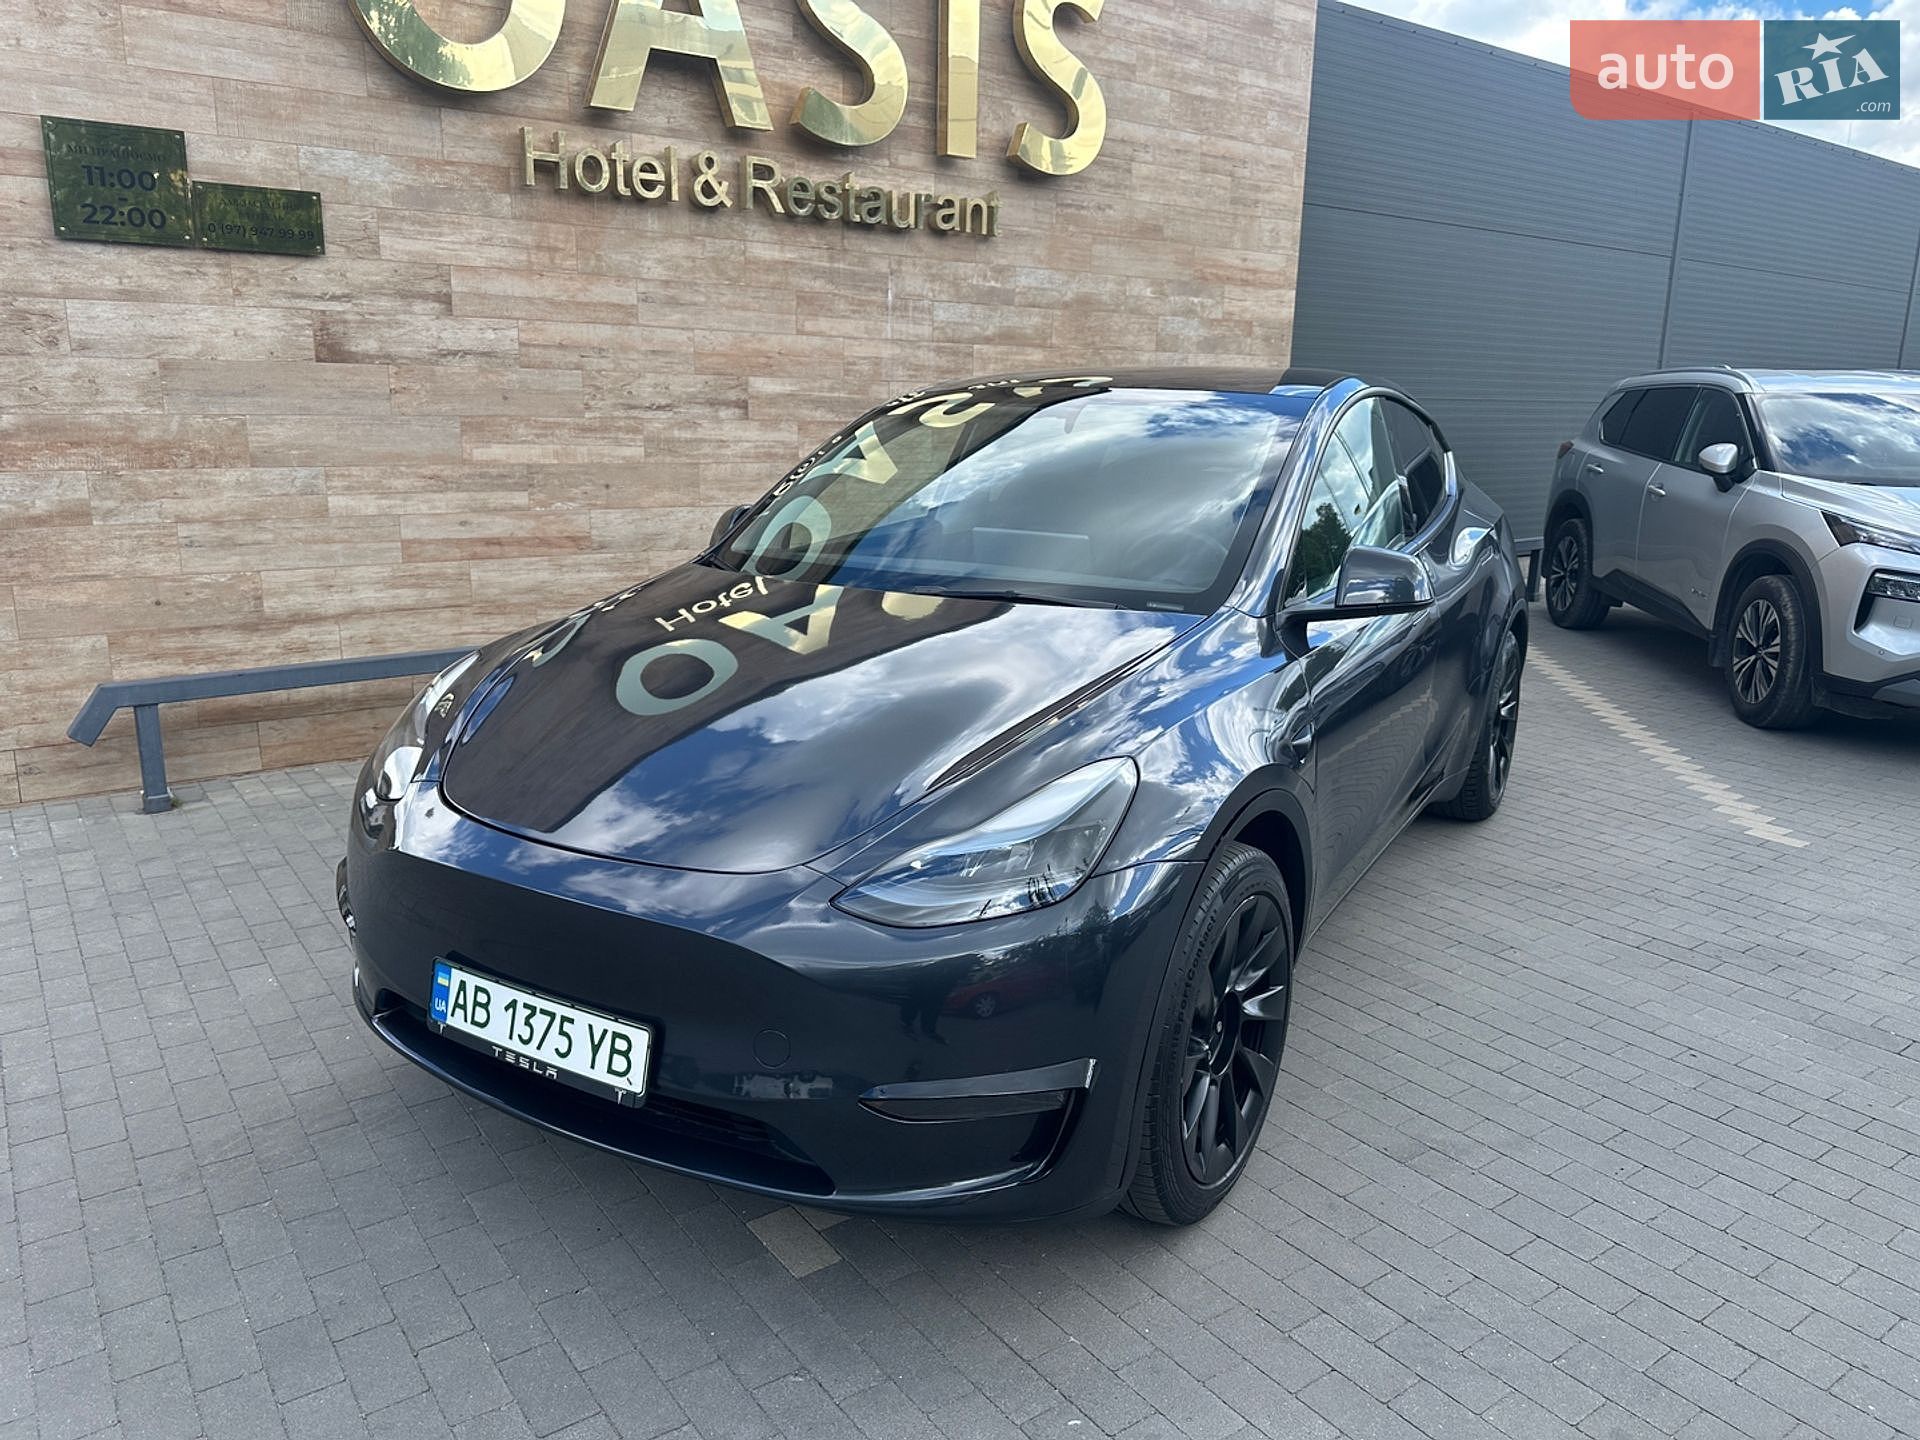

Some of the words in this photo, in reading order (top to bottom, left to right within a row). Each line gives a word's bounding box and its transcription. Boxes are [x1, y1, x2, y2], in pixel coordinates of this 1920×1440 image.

[80, 164, 158, 192] 11:00
[519, 126, 678, 202] Hotel
[691, 150, 732, 209] &
[739, 155, 1001, 237] Restaurant
[80, 203, 167, 230] 22:00
[434, 998, 447, 1014] UA
[450, 979, 491, 1029] AB
[504, 998, 575, 1059] 1375
[588, 1023, 633, 1078] YB
[492, 1045, 558, 1080] TESLA
